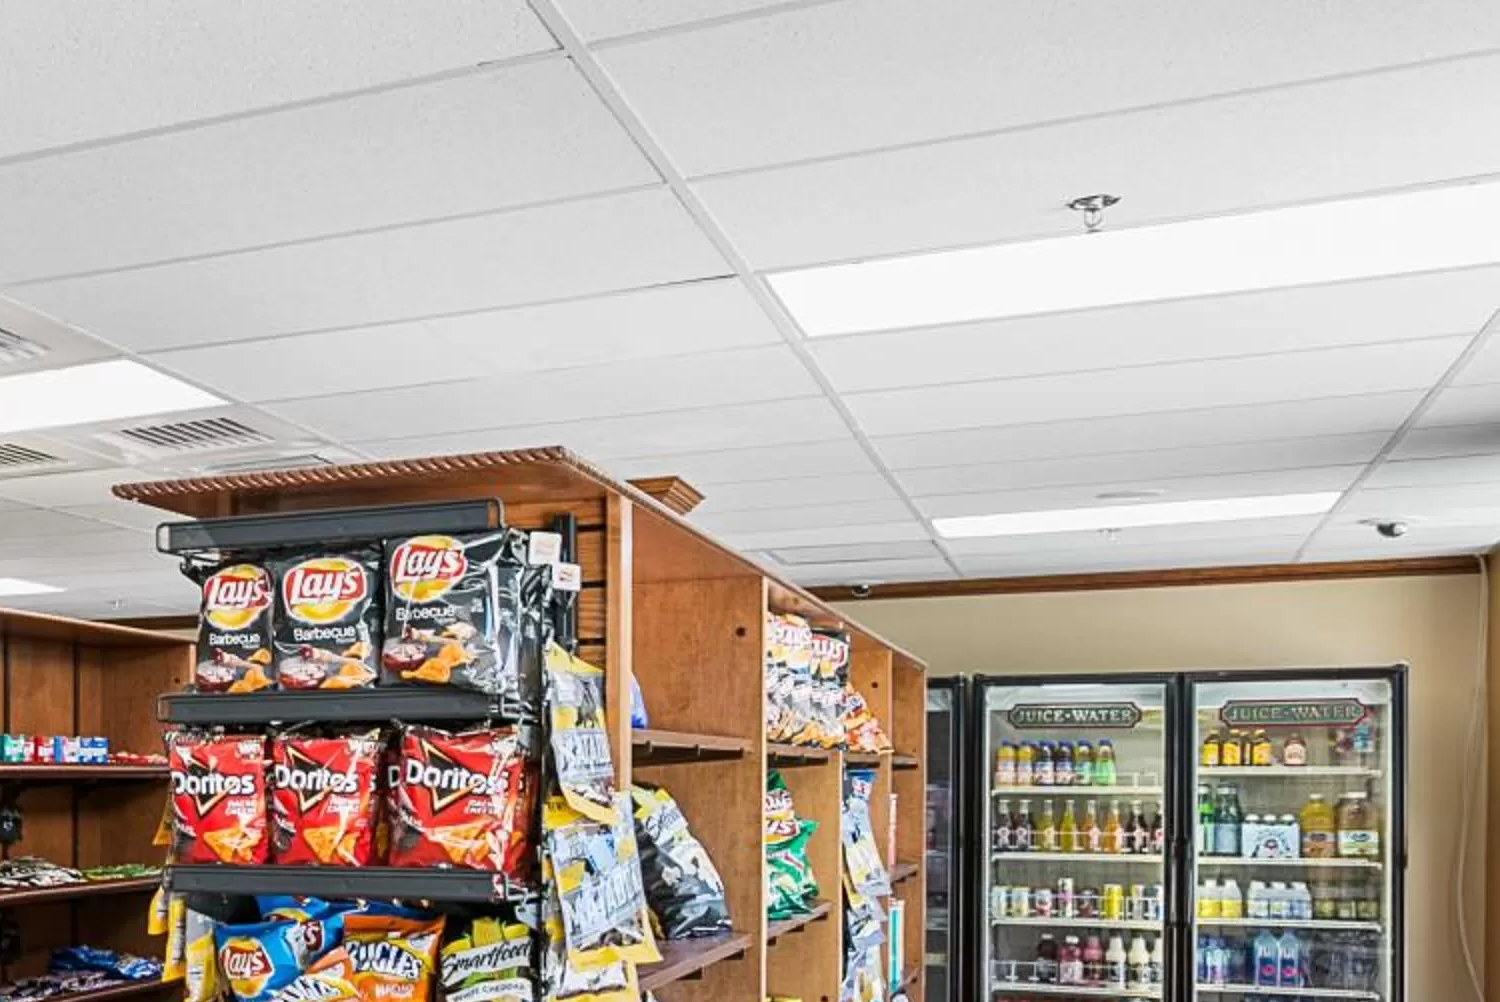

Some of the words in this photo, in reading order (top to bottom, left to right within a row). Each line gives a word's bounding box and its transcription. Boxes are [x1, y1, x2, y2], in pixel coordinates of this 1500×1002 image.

[209, 632, 261, 647] Barbecue
[293, 626, 357, 643] Barbecue
[171, 771, 256, 796] Doritos
[274, 765, 358, 794] Doritos
